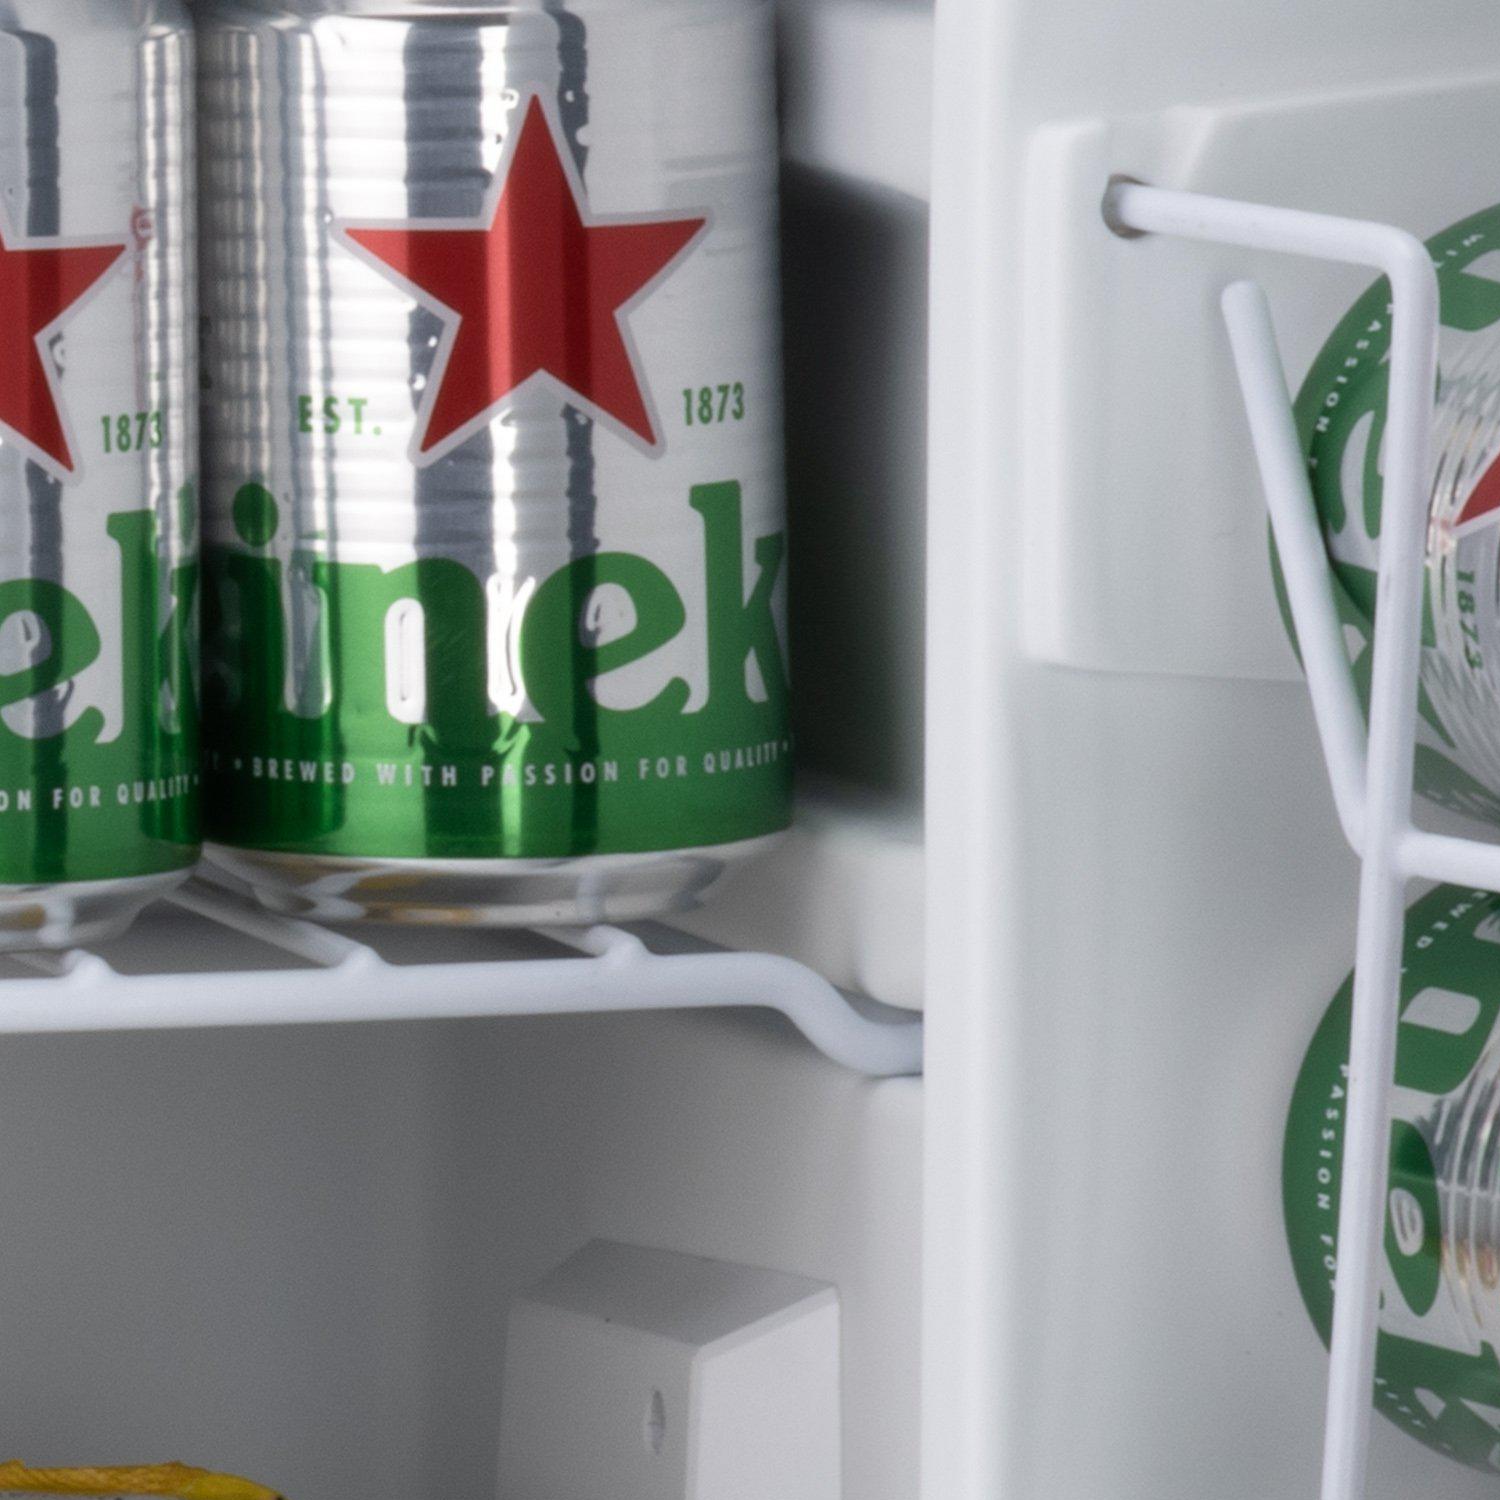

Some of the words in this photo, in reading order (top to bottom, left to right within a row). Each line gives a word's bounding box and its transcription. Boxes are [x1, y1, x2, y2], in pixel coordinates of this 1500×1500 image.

[298, 394, 383, 437] EST.
[683, 382, 746, 428] 1873
[101, 414, 163, 453] 1873
[252, 755, 356, 784] BREWED
[375, 762, 458, 787] WITH
[480, 760, 619, 787] PASSION
[638, 755, 688, 780] FOR
[702, 740, 779, 774] QUALITY
[52, 785, 101, 810] FOR
